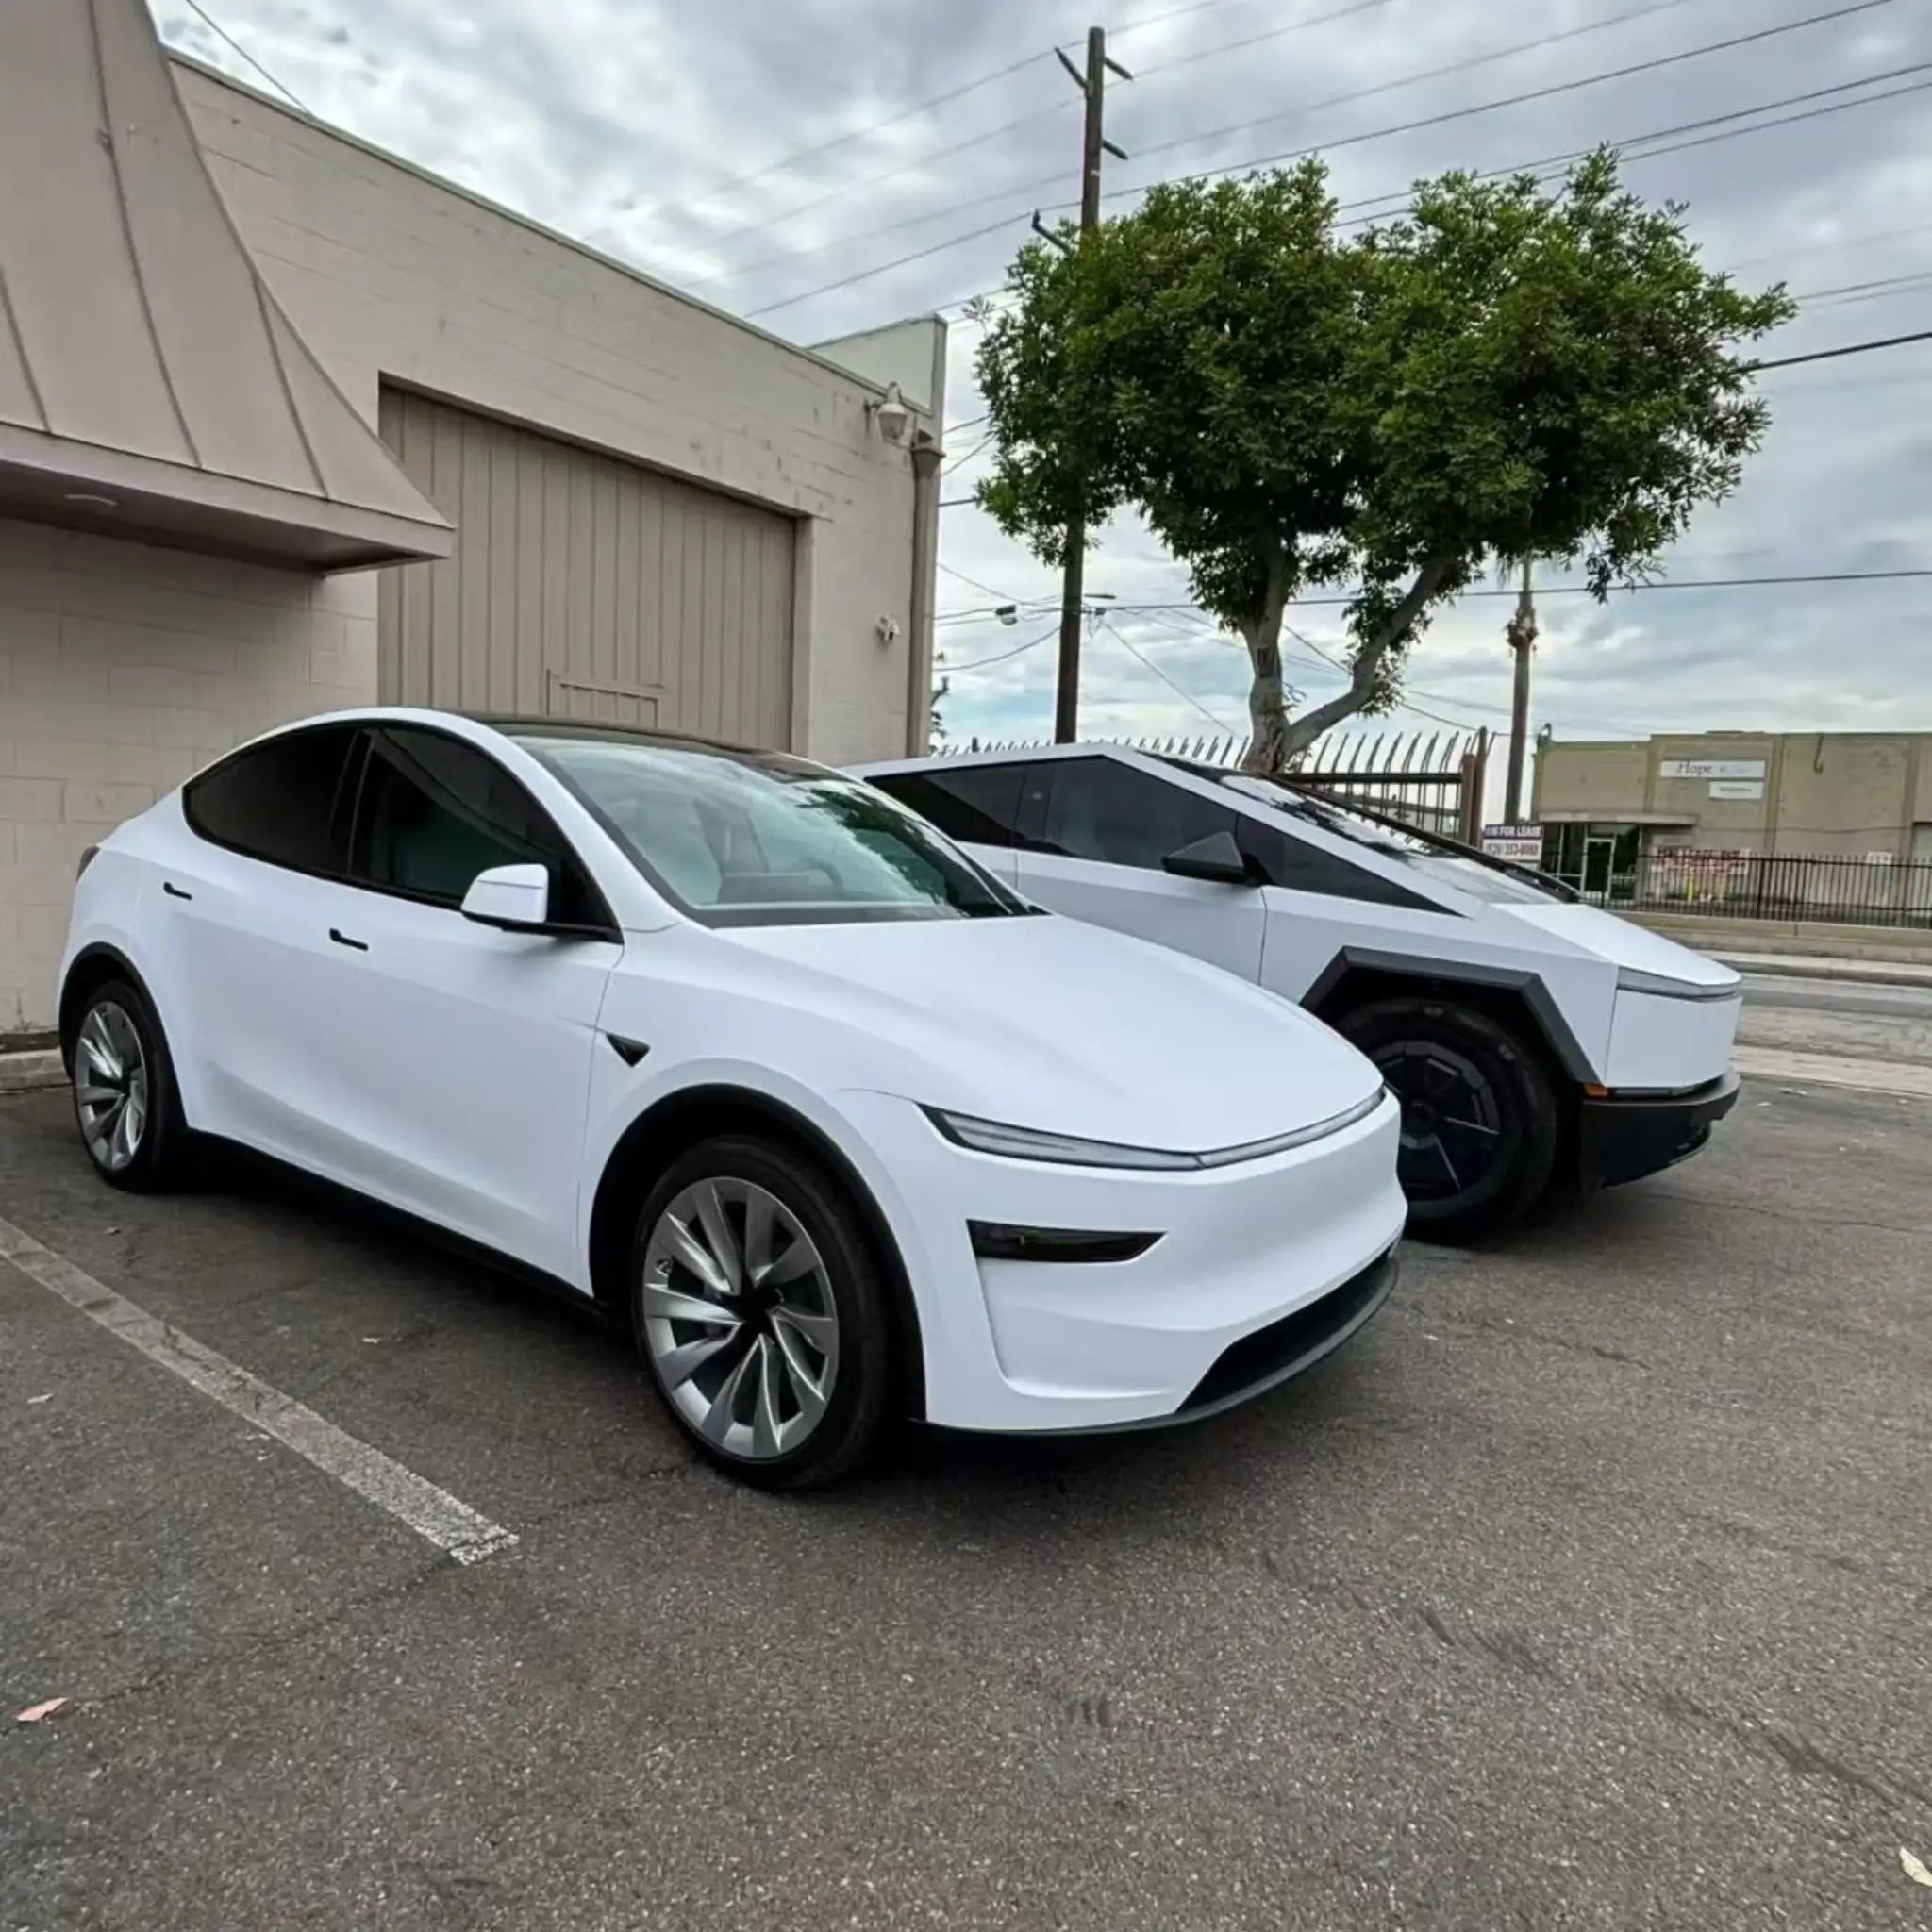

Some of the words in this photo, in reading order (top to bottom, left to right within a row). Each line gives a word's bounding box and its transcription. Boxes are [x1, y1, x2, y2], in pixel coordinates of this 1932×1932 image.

[1677, 759, 1712, 777] Hope
[1500, 826, 1515, 837] FOR
[1517, 826, 1541, 837] LEASE
